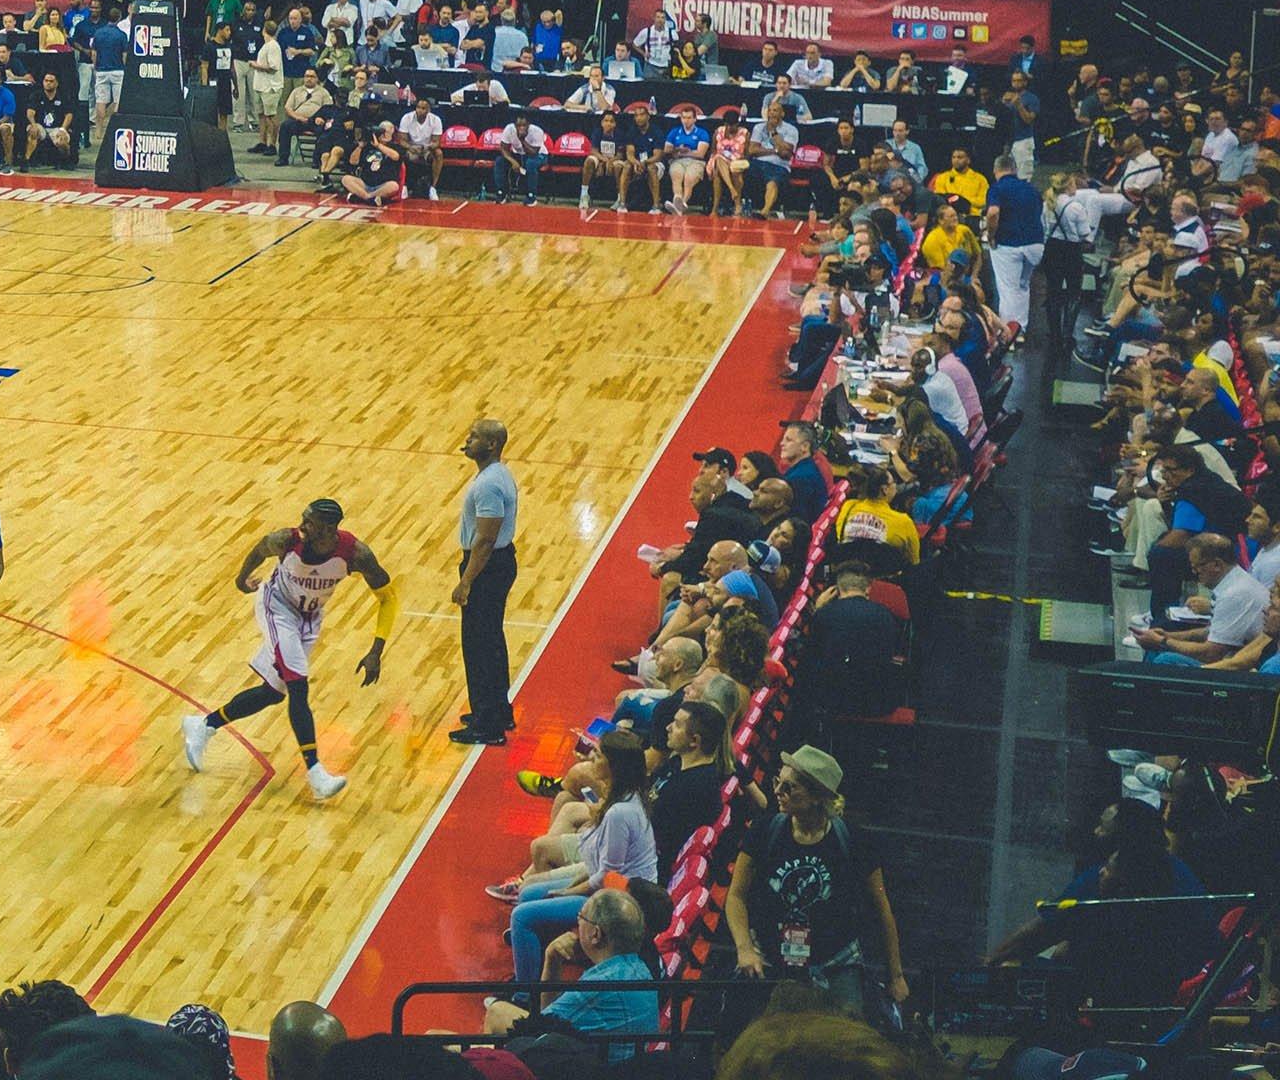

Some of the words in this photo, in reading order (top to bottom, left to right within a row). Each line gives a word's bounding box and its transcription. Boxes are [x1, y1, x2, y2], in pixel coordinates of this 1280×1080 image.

[766, 3, 832, 41] LEAGUE
[892, 5, 989, 24] #NBASummer
[139, 63, 163, 79] @NBA
[136, 135, 177, 155] SUMMER
[135, 153, 170, 172] LEAGUE
[171, 198, 378, 222] LEAGUE
